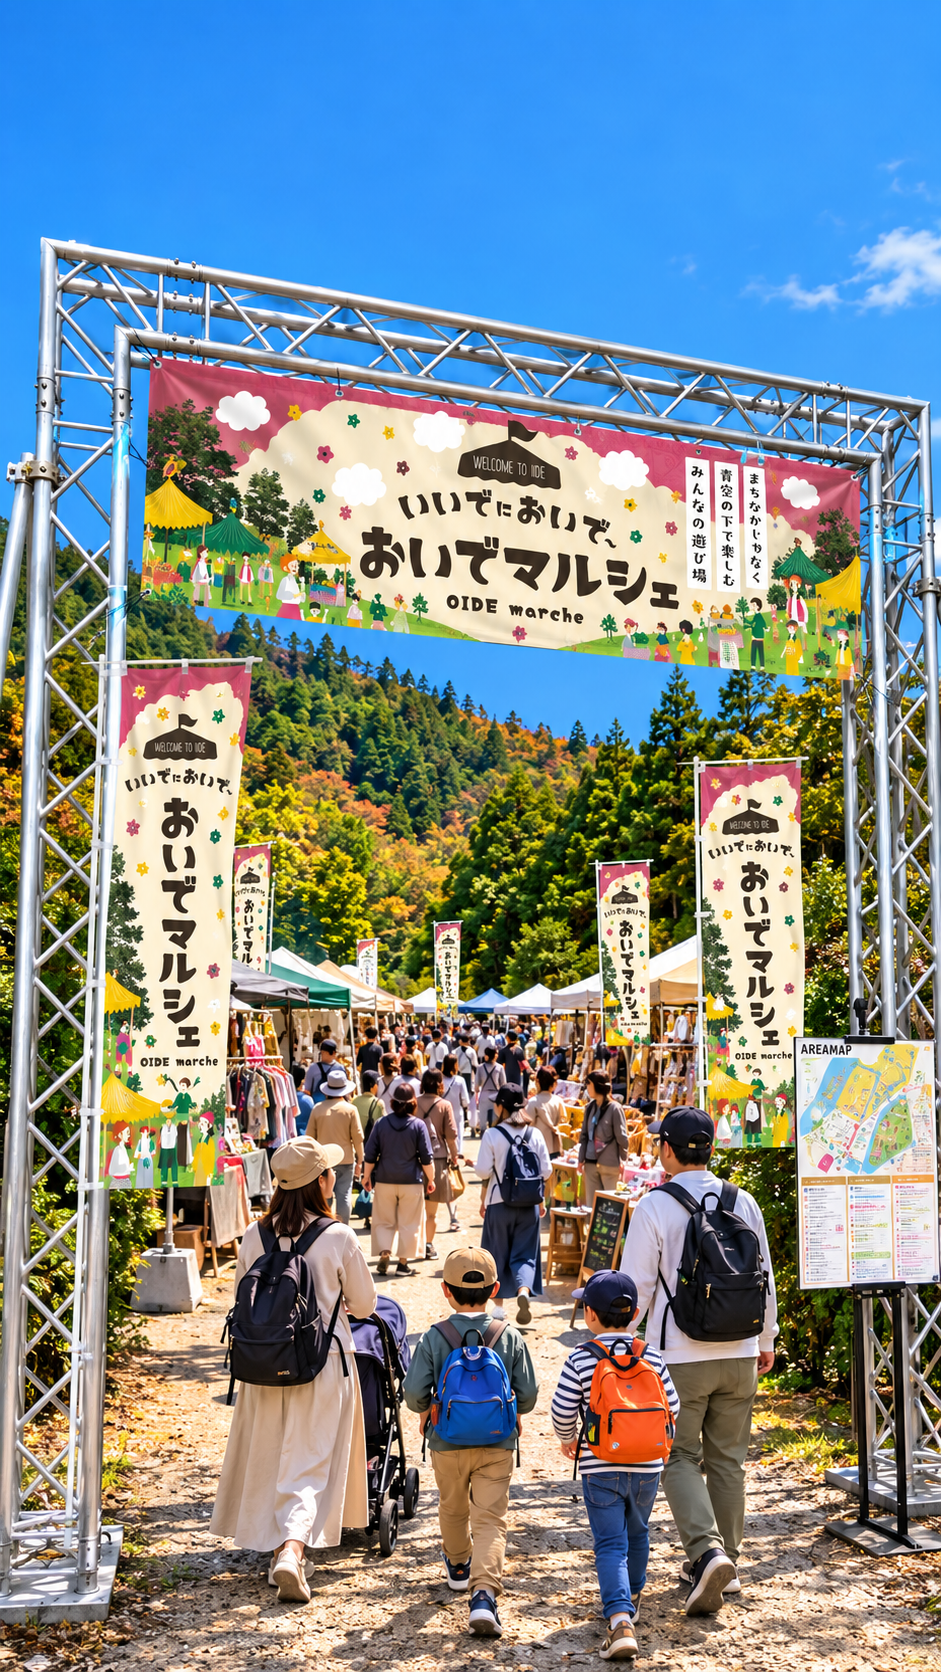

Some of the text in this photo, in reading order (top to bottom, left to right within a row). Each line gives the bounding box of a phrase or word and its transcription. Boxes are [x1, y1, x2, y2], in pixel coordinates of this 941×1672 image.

[473, 455, 546, 479] WELCOME TO IIDE
[691, 466, 706, 583] みんなの遊び場
[720, 469, 735, 587] 青空の下で楽しむ
[749, 473, 762, 583] まちなかじゃなく
[360, 526, 680, 610] おいでマルシェ
[446, 595, 584, 624] OIDE marche
[154, 741, 183, 753] WELCOME
[185, 742, 193, 753] TO
[159, 797, 200, 1048] おいでマルシェ
[242, 898, 254, 967] おいでマル
[740, 861, 780, 1046] おいでマルシェ
[619, 920, 640, 1019] おいでマルシェ
[140, 1056, 218, 1067] OIDE marche
[735, 1051, 792, 1060] OIDE marche
[801, 1043, 852, 1055] AREAMAP
